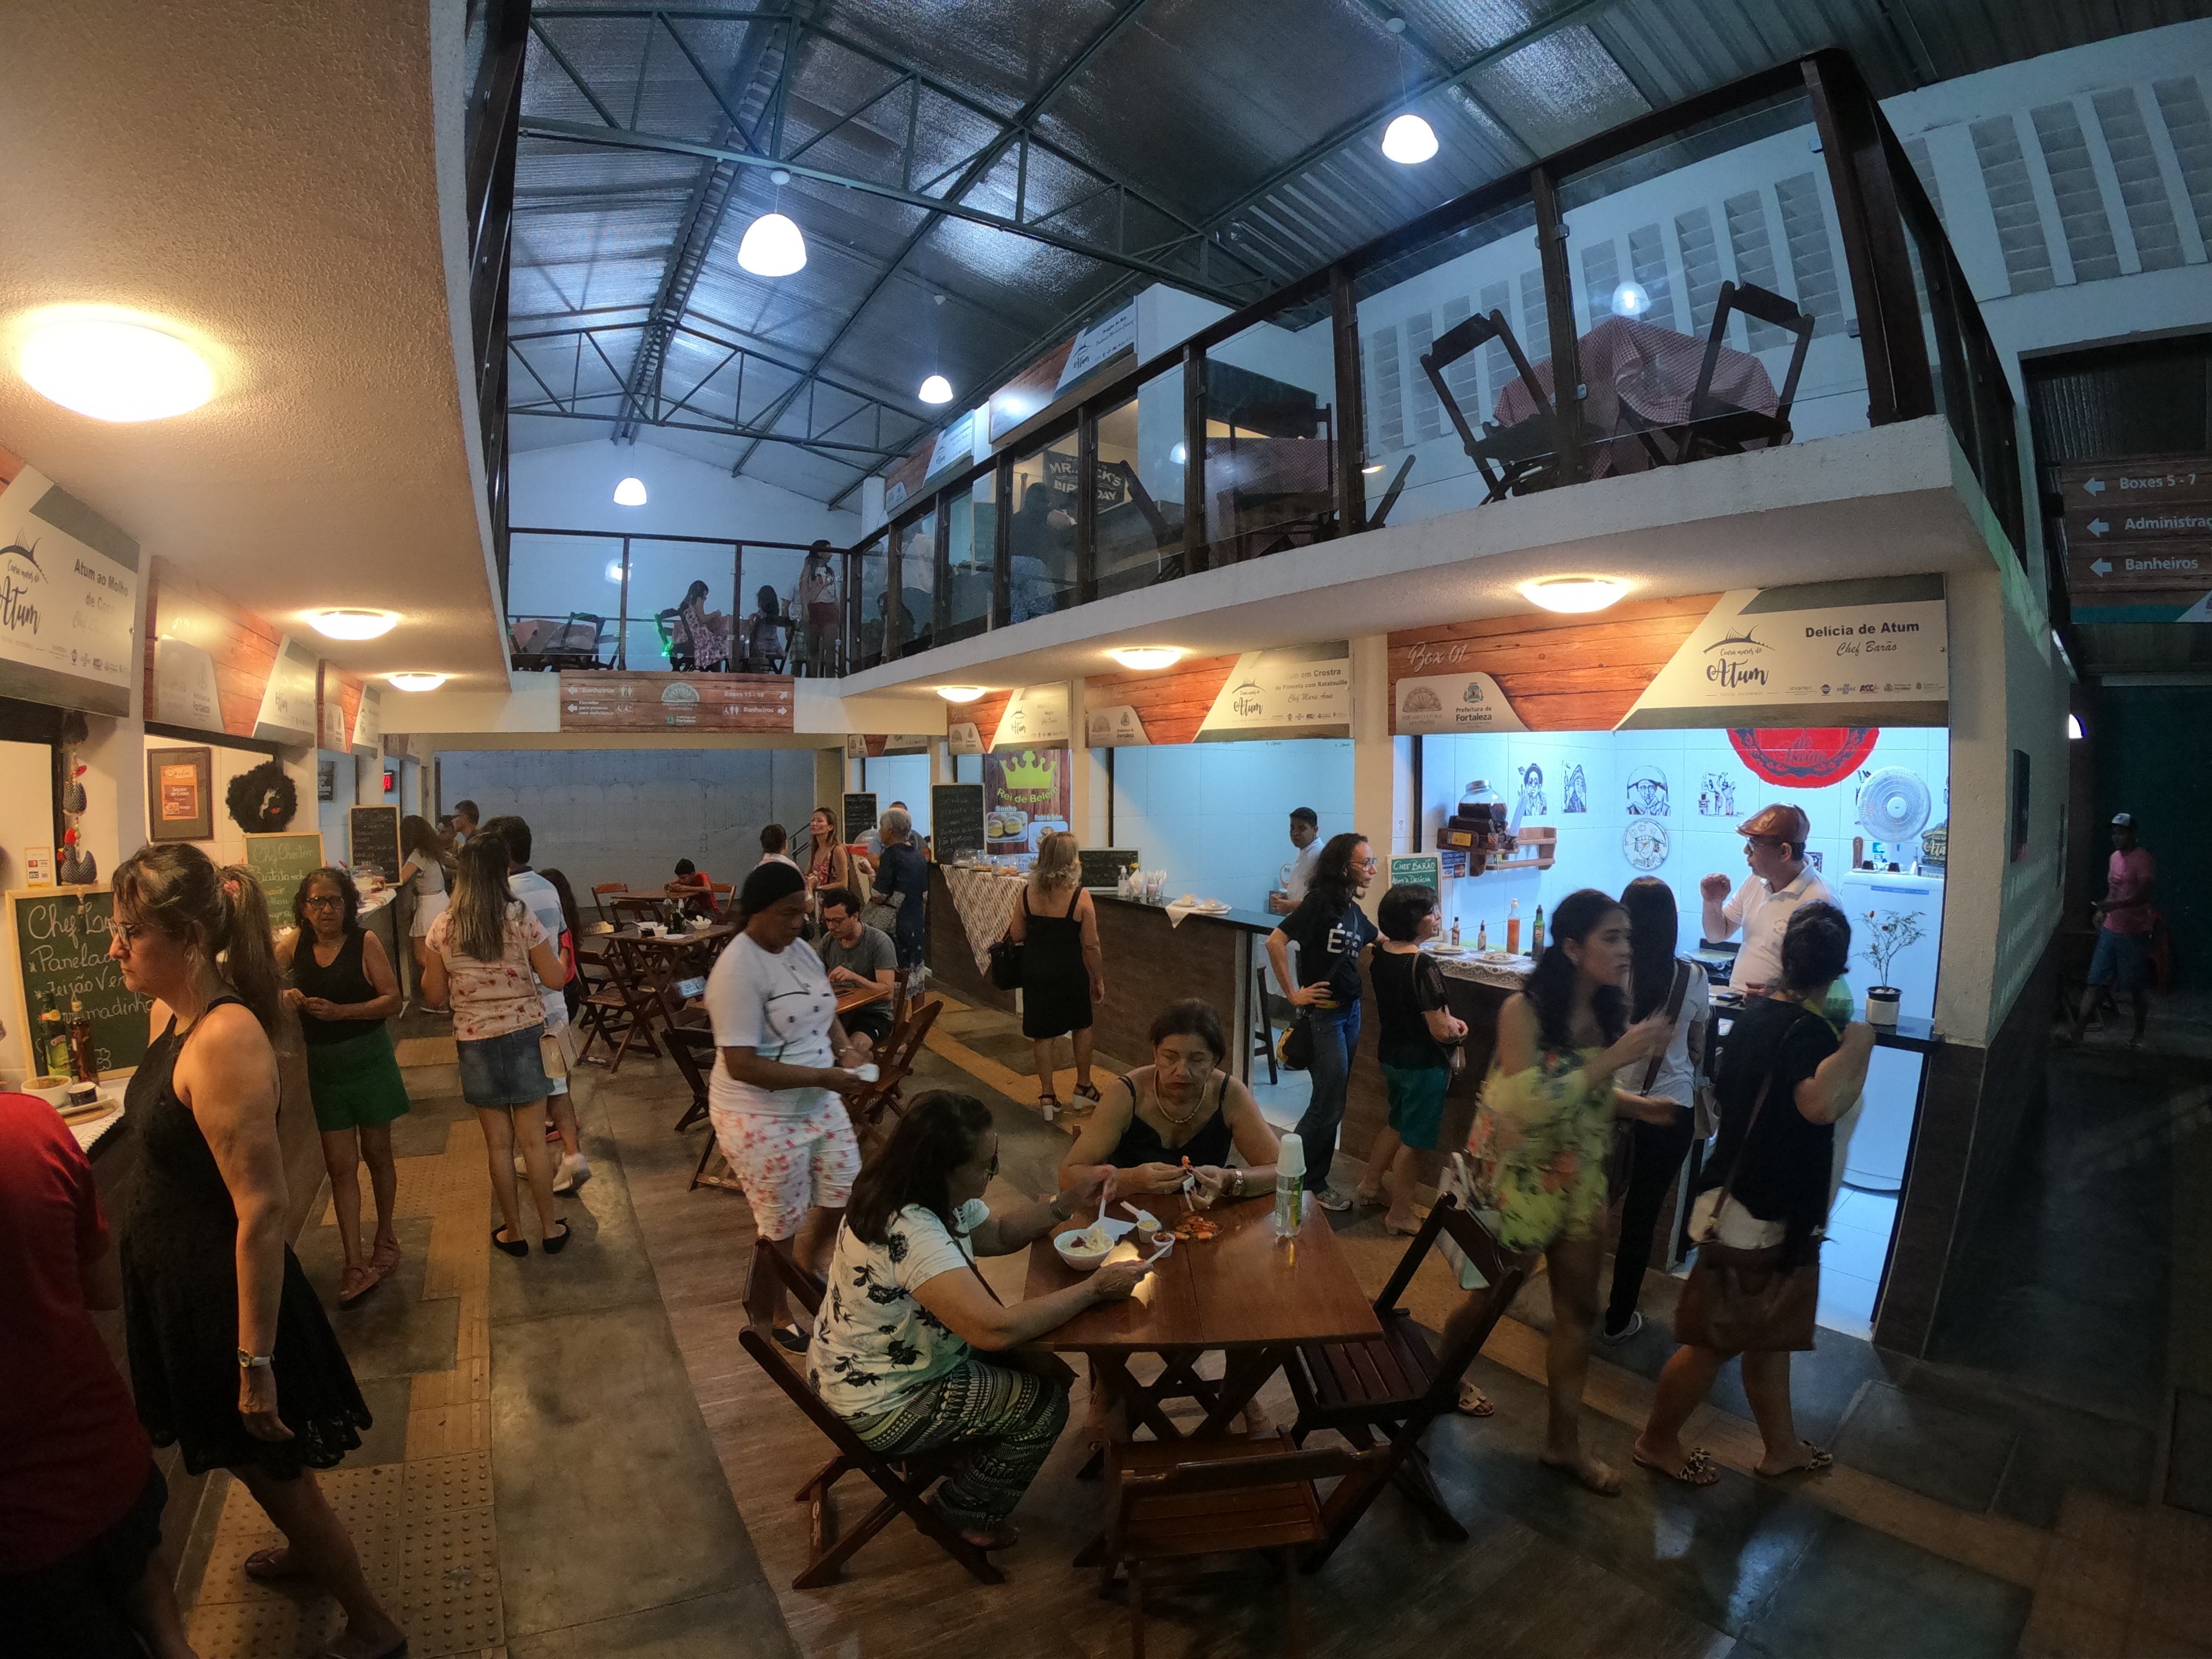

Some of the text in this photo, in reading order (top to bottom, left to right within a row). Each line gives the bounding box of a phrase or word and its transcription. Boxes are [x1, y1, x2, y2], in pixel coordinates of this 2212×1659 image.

[2120, 476, 2163, 490] Boxes
[2167, 474, 2176, 487] 5
[2188, 473, 2197, 486] 7
[2125, 557, 2199, 571] Banheiros
[74, 559, 95, 581] Atum
[97, 573, 106, 586] ao
[86, 592, 95, 608] de
[1806, 622, 1919, 638] Delícia de Atum
[1837, 640, 1897, 656] Chef Barão
[1408, 641, 1468, 672] Box 01
[1314, 668, 1342, 677] Crostra
[1706, 658, 1770, 688] Atum
[1233, 697, 1264, 717] Atum
[1455, 713, 1492, 722] Fortaleza
[997, 787, 1013, 801] Rei
[1014, 794, 1027, 803] de
[1410, 858, 1436, 870] BARÃO
[1327, 922, 1345, 953] É
